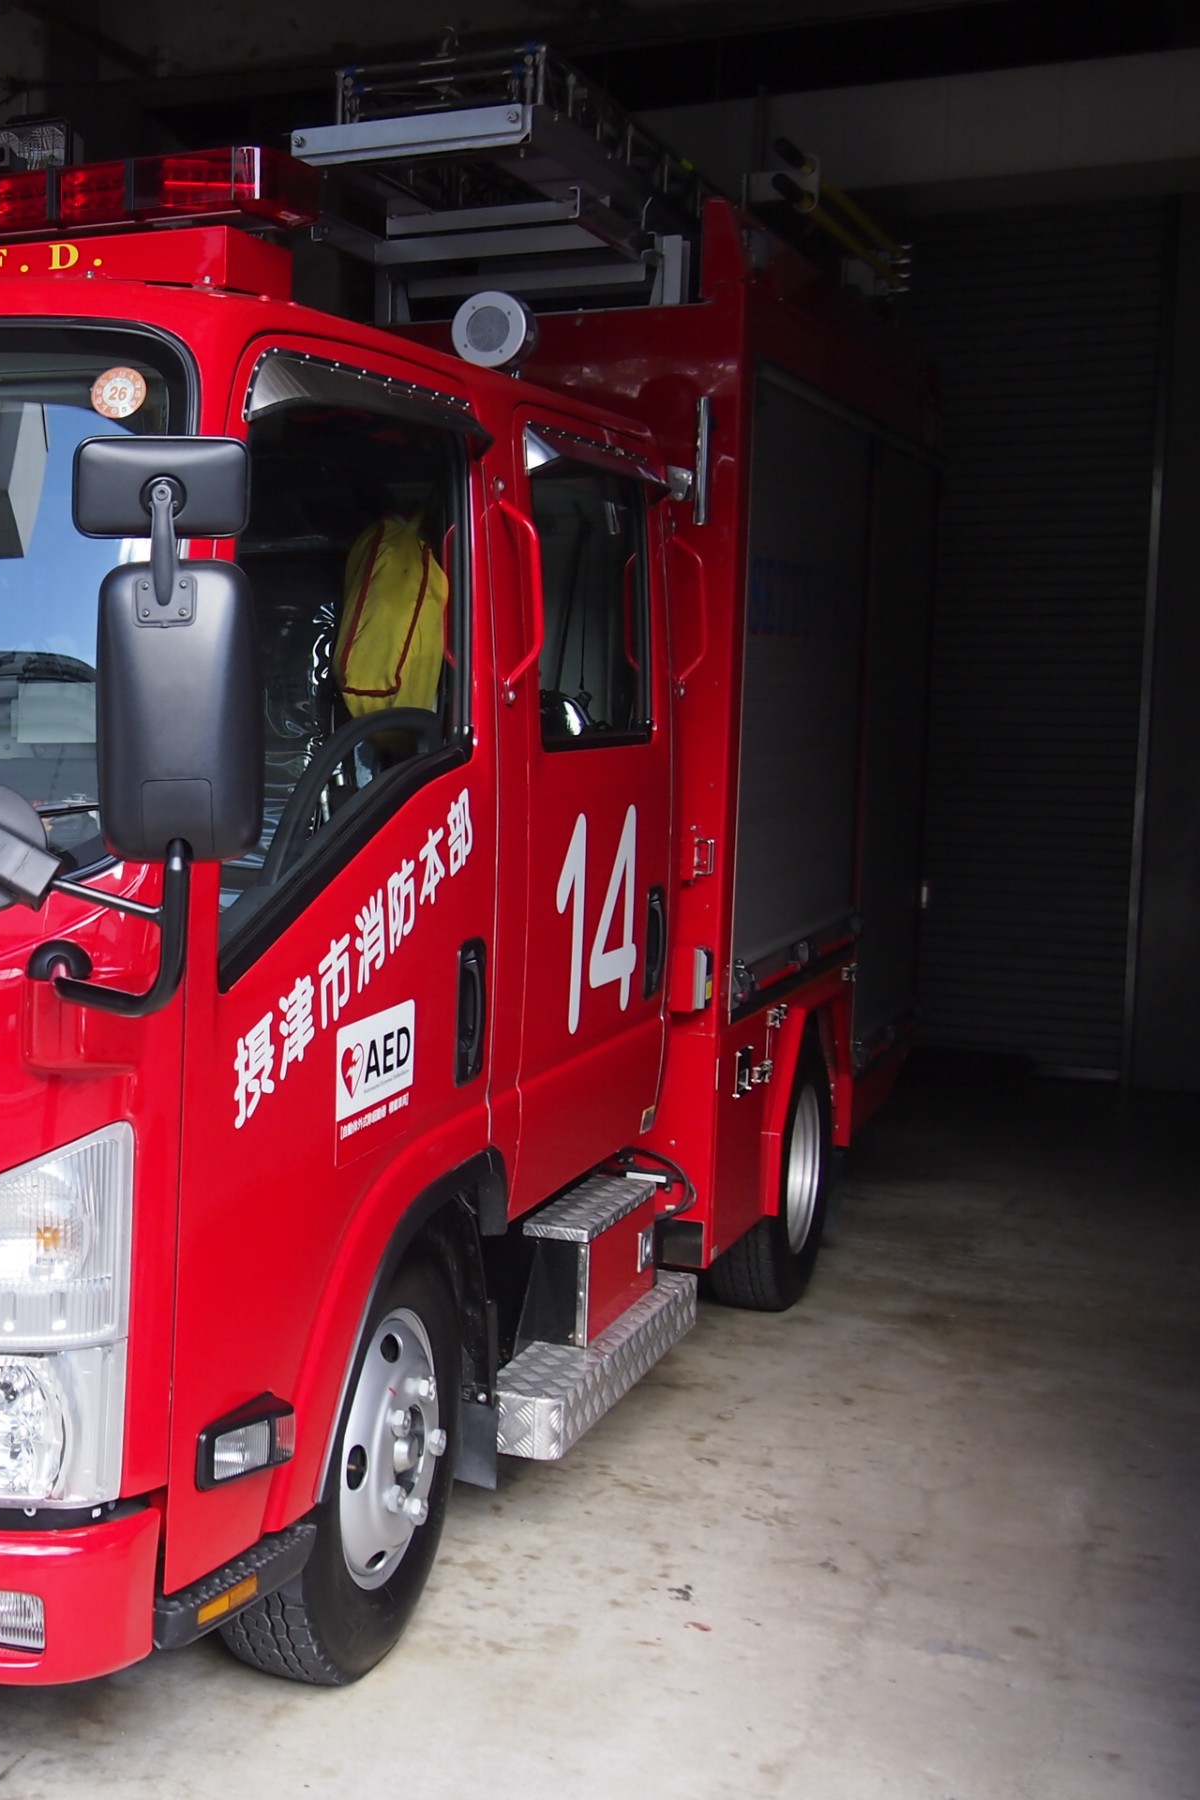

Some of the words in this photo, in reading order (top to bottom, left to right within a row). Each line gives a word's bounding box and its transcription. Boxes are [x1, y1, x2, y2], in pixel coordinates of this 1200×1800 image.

[109, 386, 128, 401] 26
[234, 788, 473, 1129] 摂津市消防本部
[556, 804, 637, 1034] 14
[364, 1026, 411, 1084] AED
